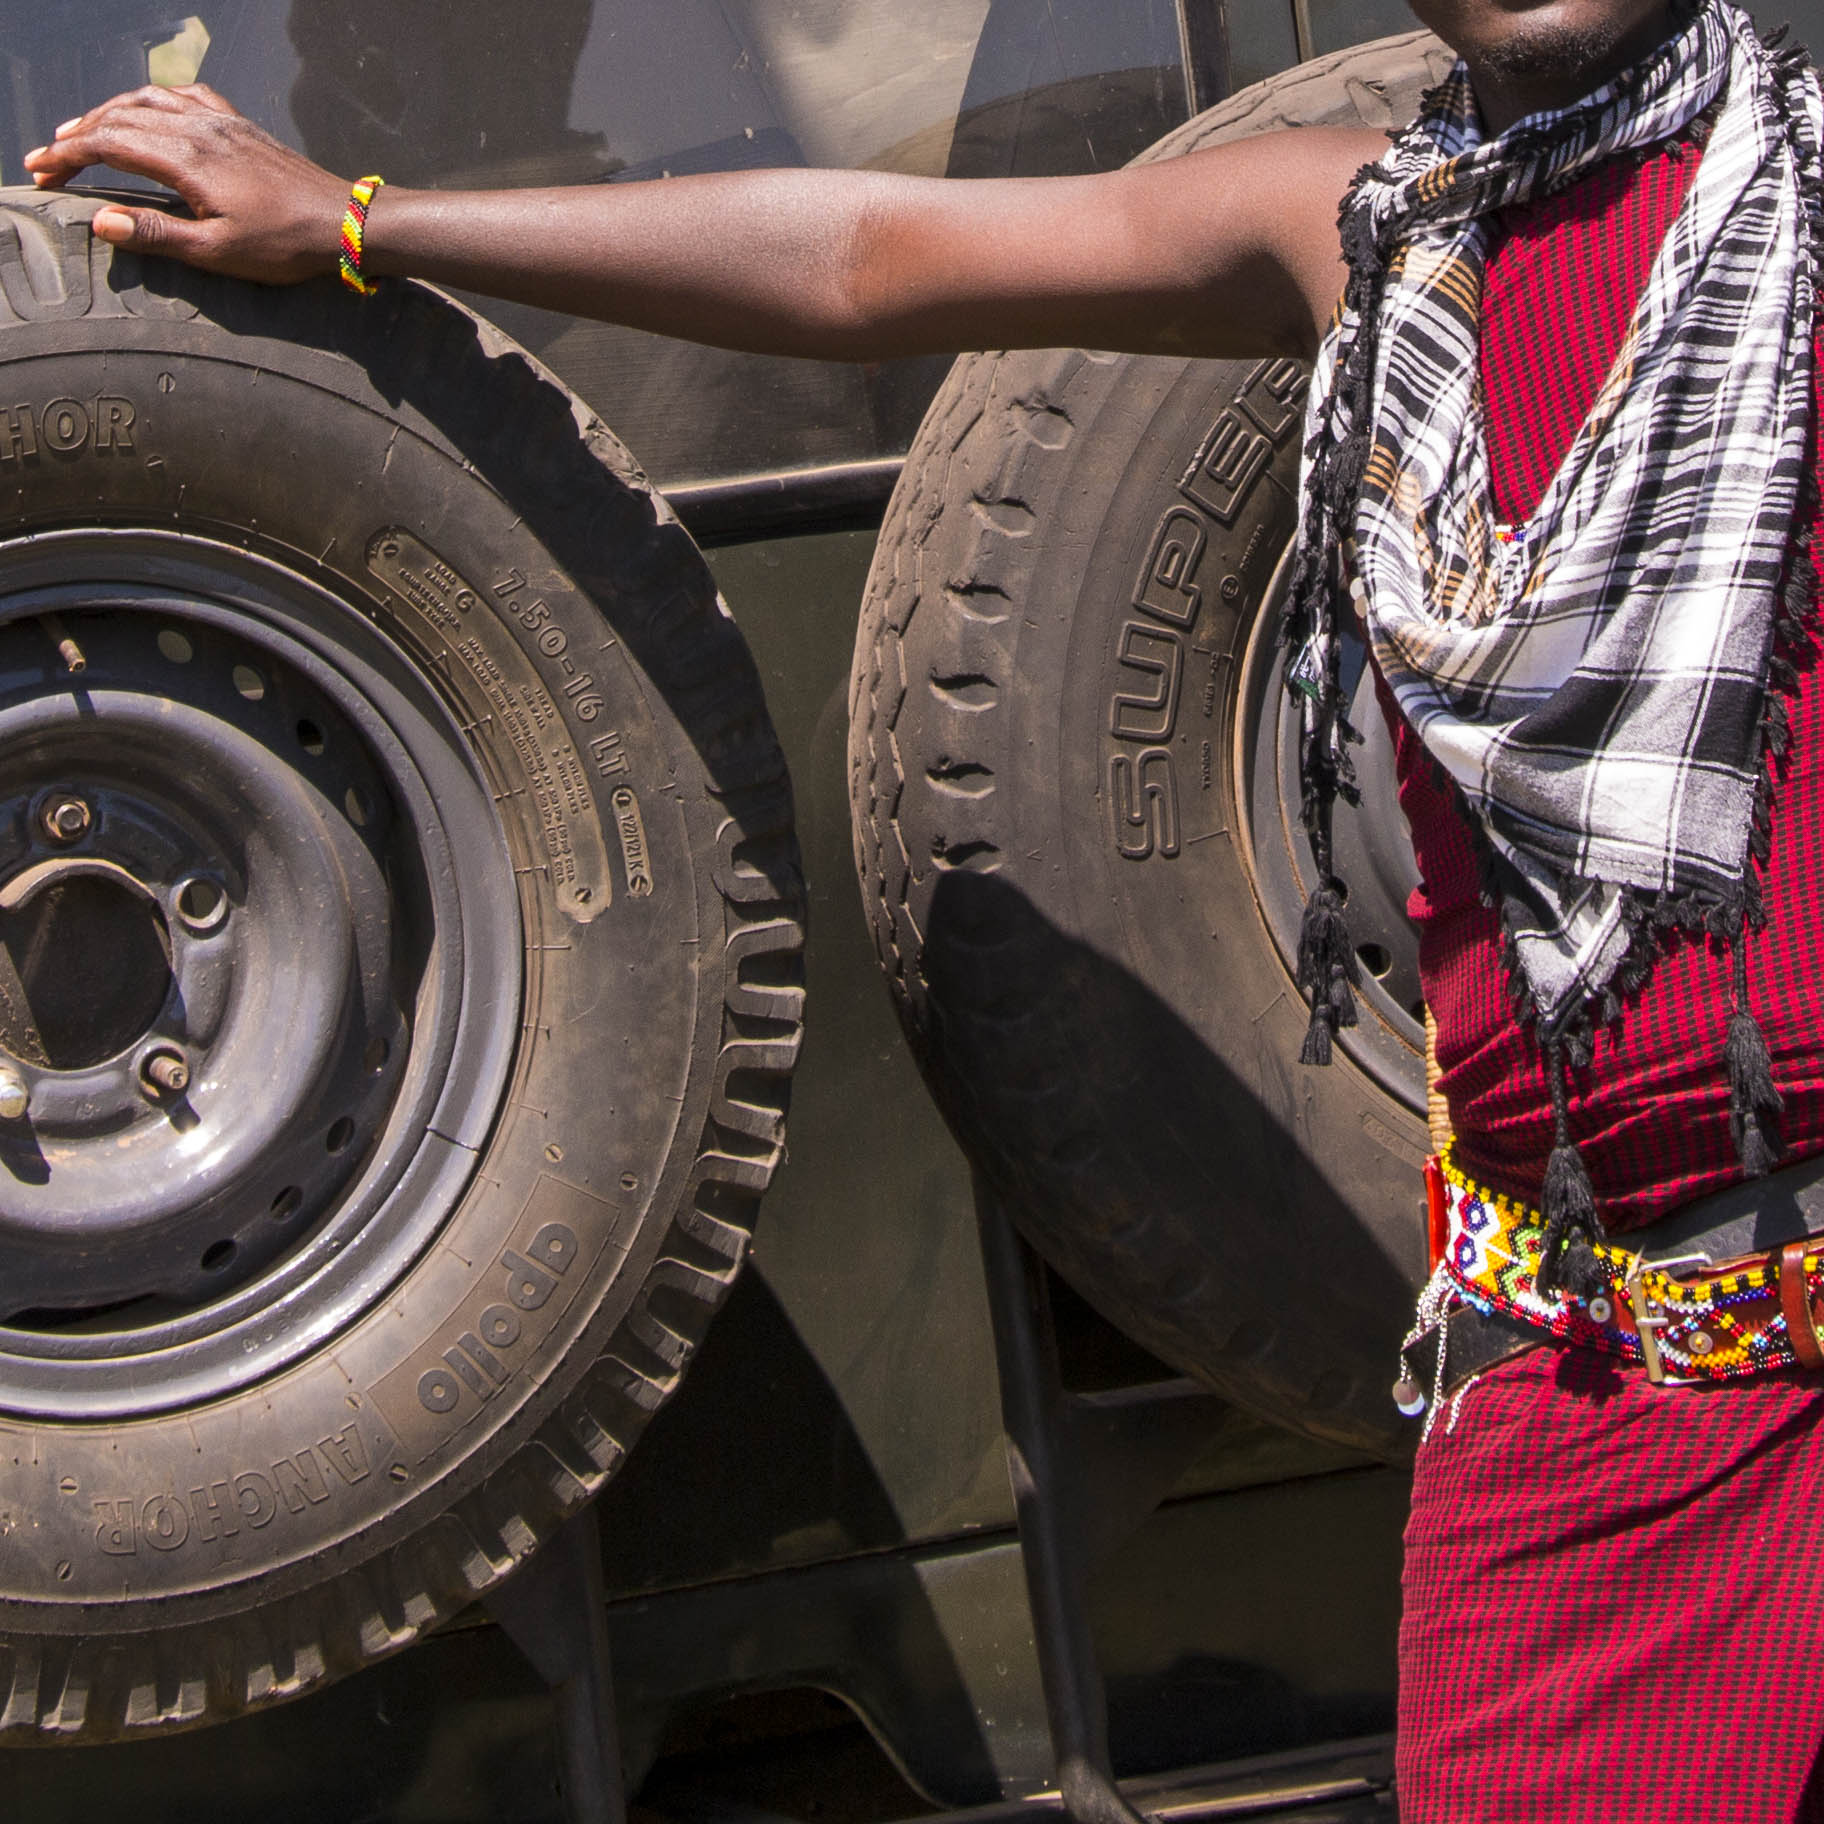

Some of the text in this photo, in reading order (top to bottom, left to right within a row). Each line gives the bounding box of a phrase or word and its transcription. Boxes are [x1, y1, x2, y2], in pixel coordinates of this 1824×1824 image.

[493, 568, 632, 778] 7.50-16 LT
[95, 1422, 372, 1556] ANCHOR
